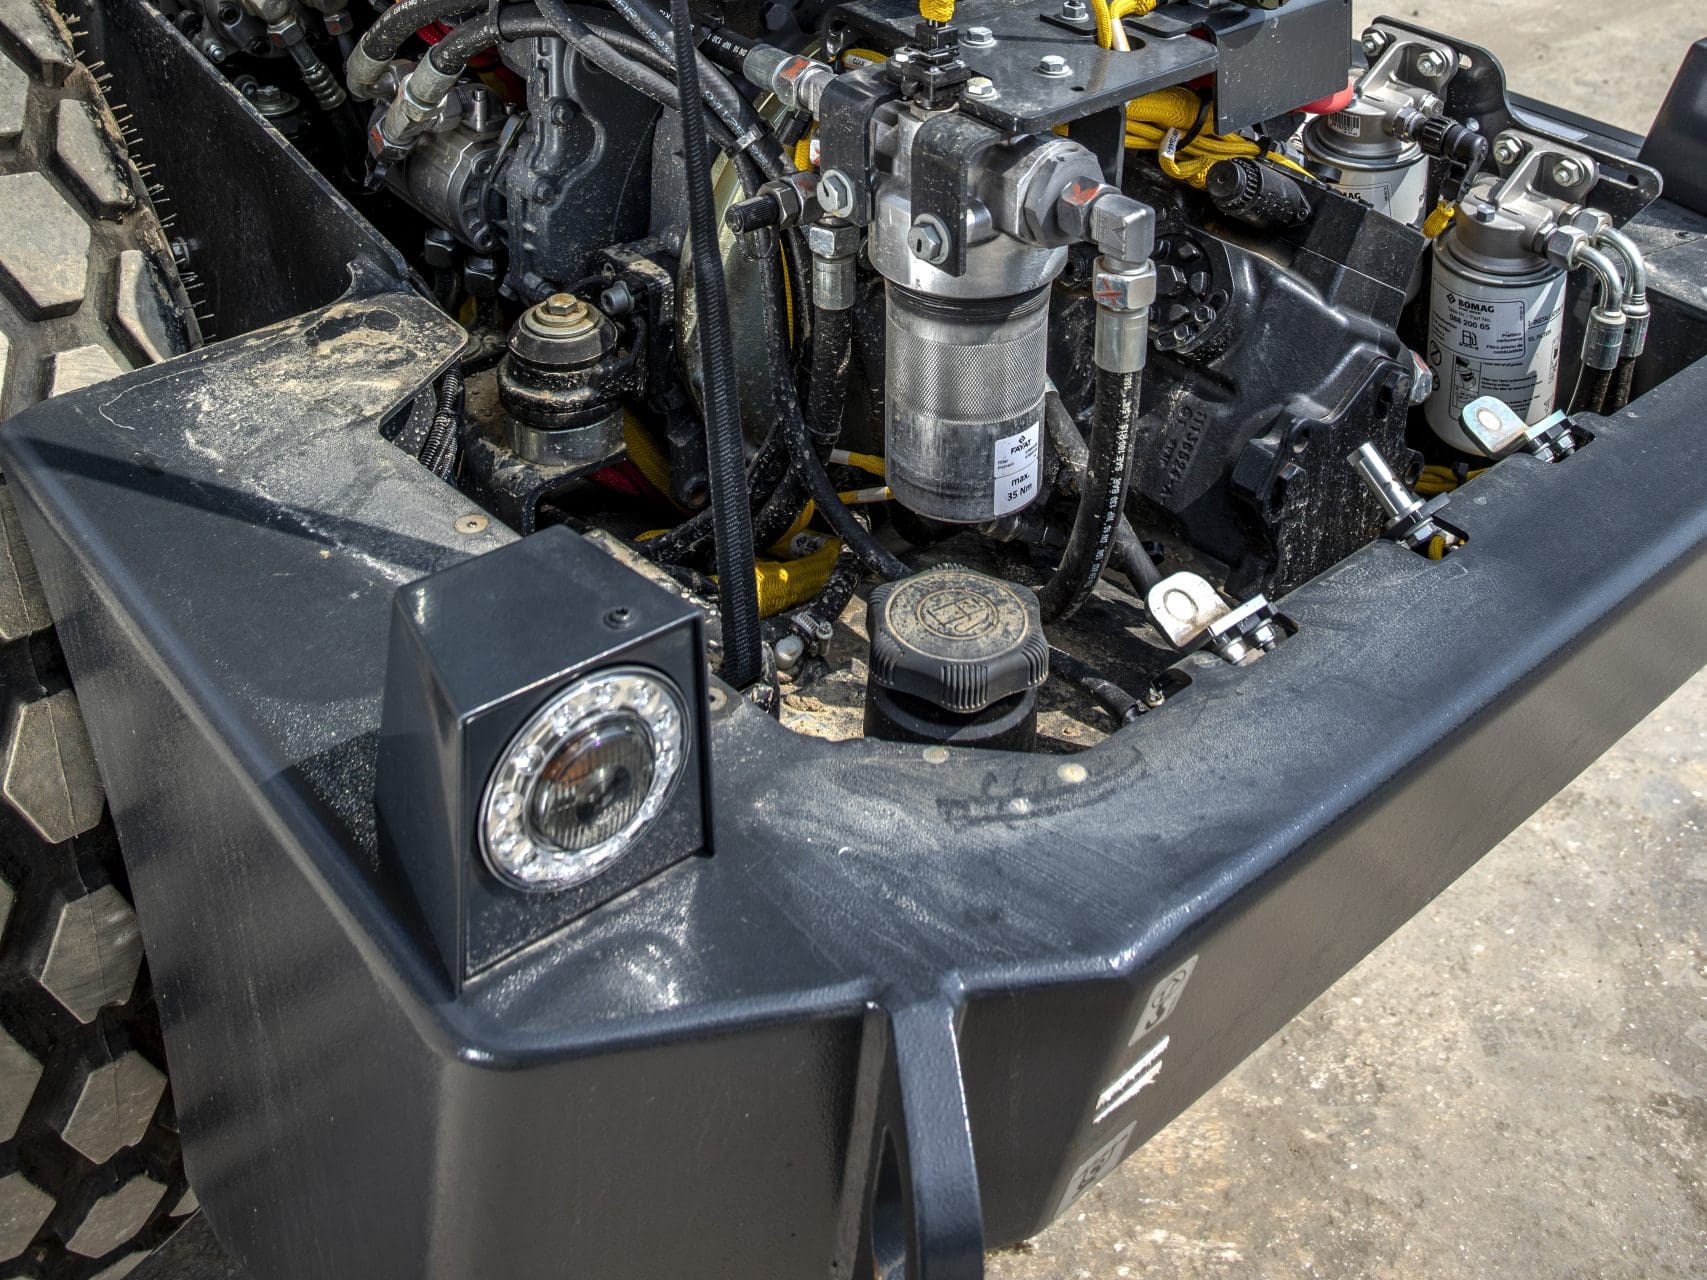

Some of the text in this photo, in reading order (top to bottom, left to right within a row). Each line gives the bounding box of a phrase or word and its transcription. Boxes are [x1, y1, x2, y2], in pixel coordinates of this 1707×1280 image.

[1458, 299, 1495, 313] BOMAG
[1463, 319, 1478, 328] 200
[1010, 438, 1032, 455] FAYAT
[1011, 472, 1030, 487] max.
[1006, 483, 1033, 502] 35 Nm
